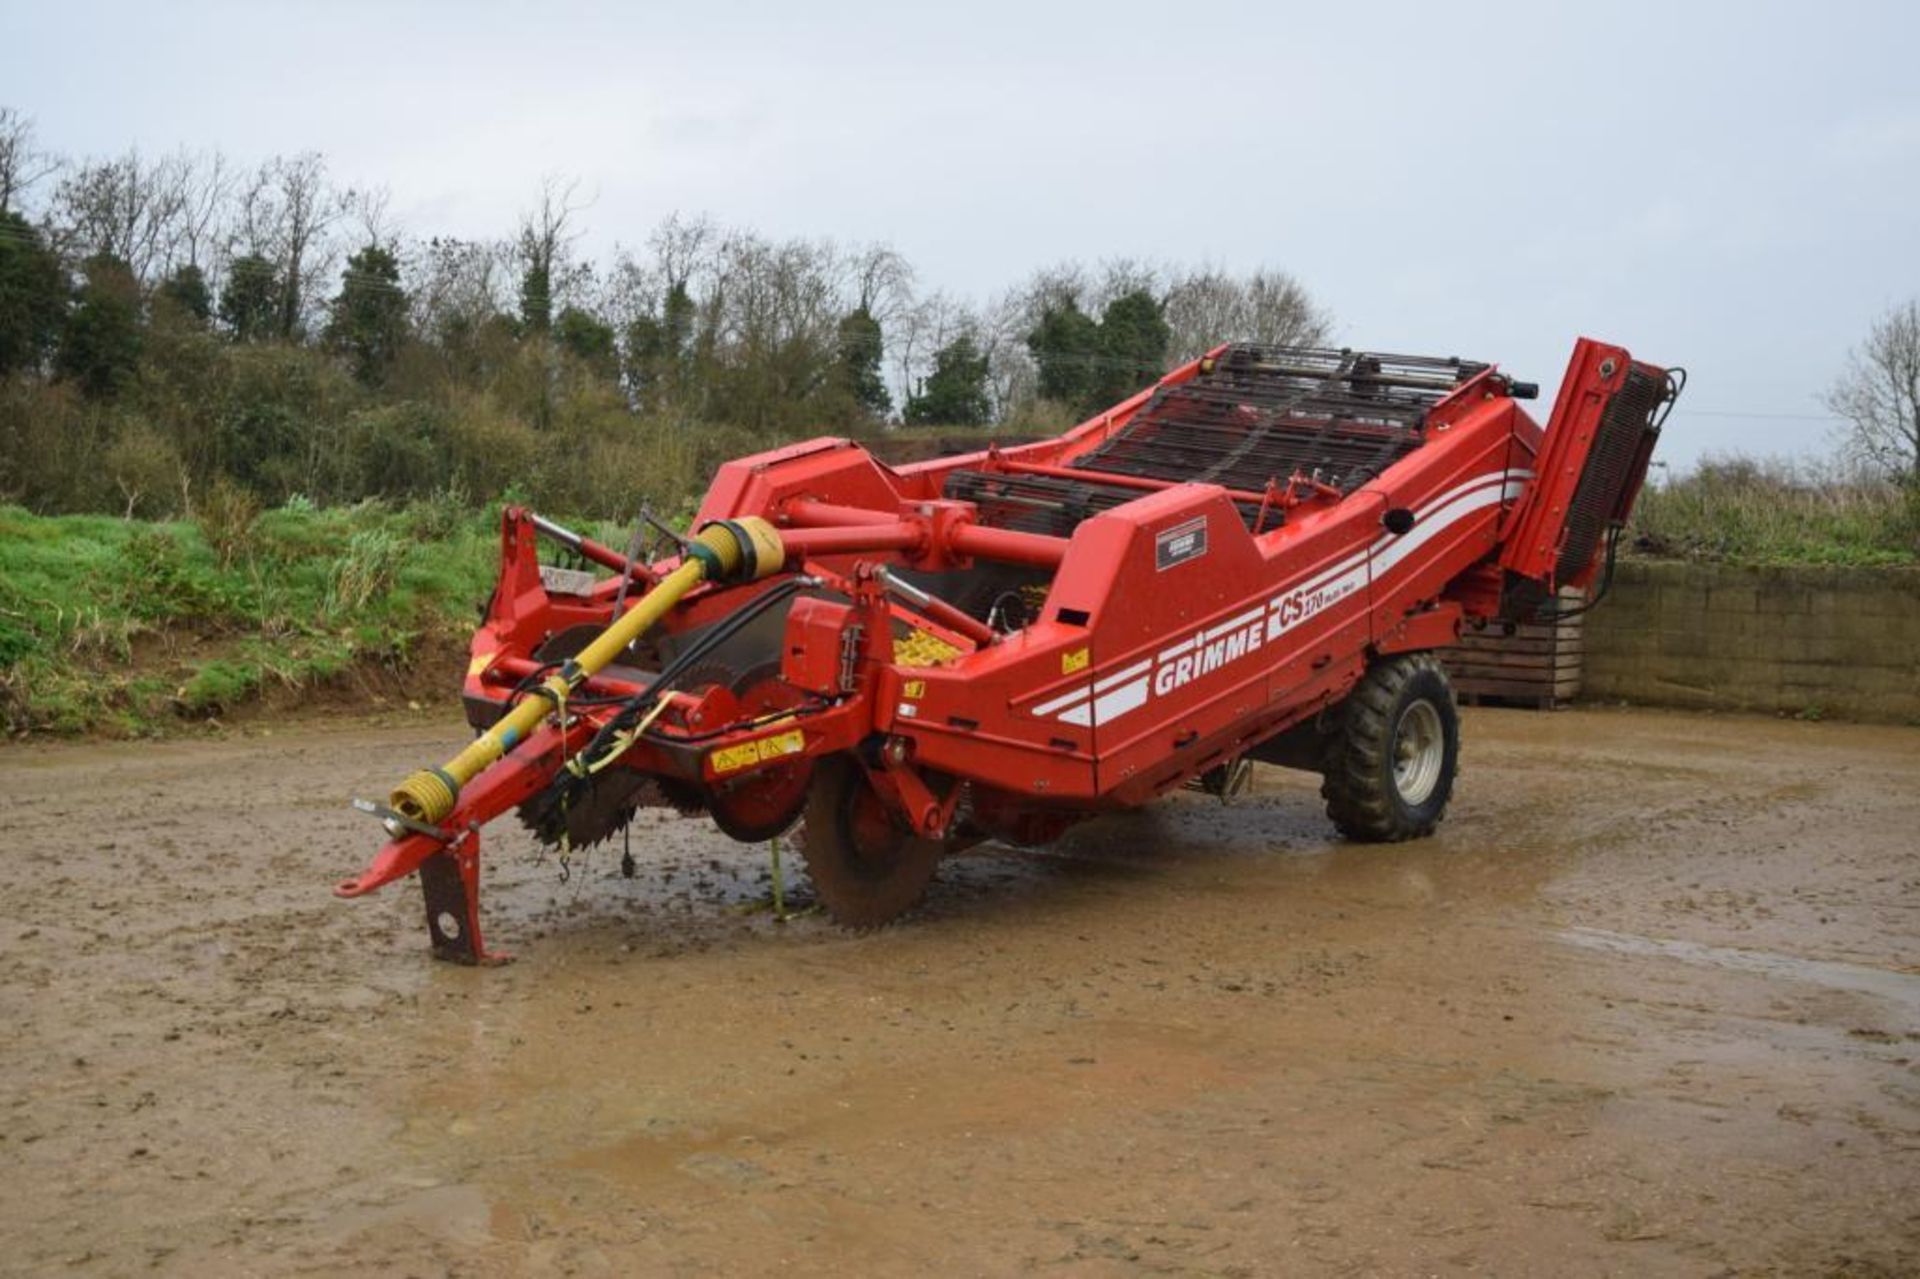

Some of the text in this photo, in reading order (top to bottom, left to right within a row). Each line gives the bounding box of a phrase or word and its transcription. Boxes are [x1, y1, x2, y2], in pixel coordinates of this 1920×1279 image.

[1155, 620, 1264, 697] GRIMME
[1279, 591, 1303, 628] CS
[1304, 591, 1323, 617] 170
